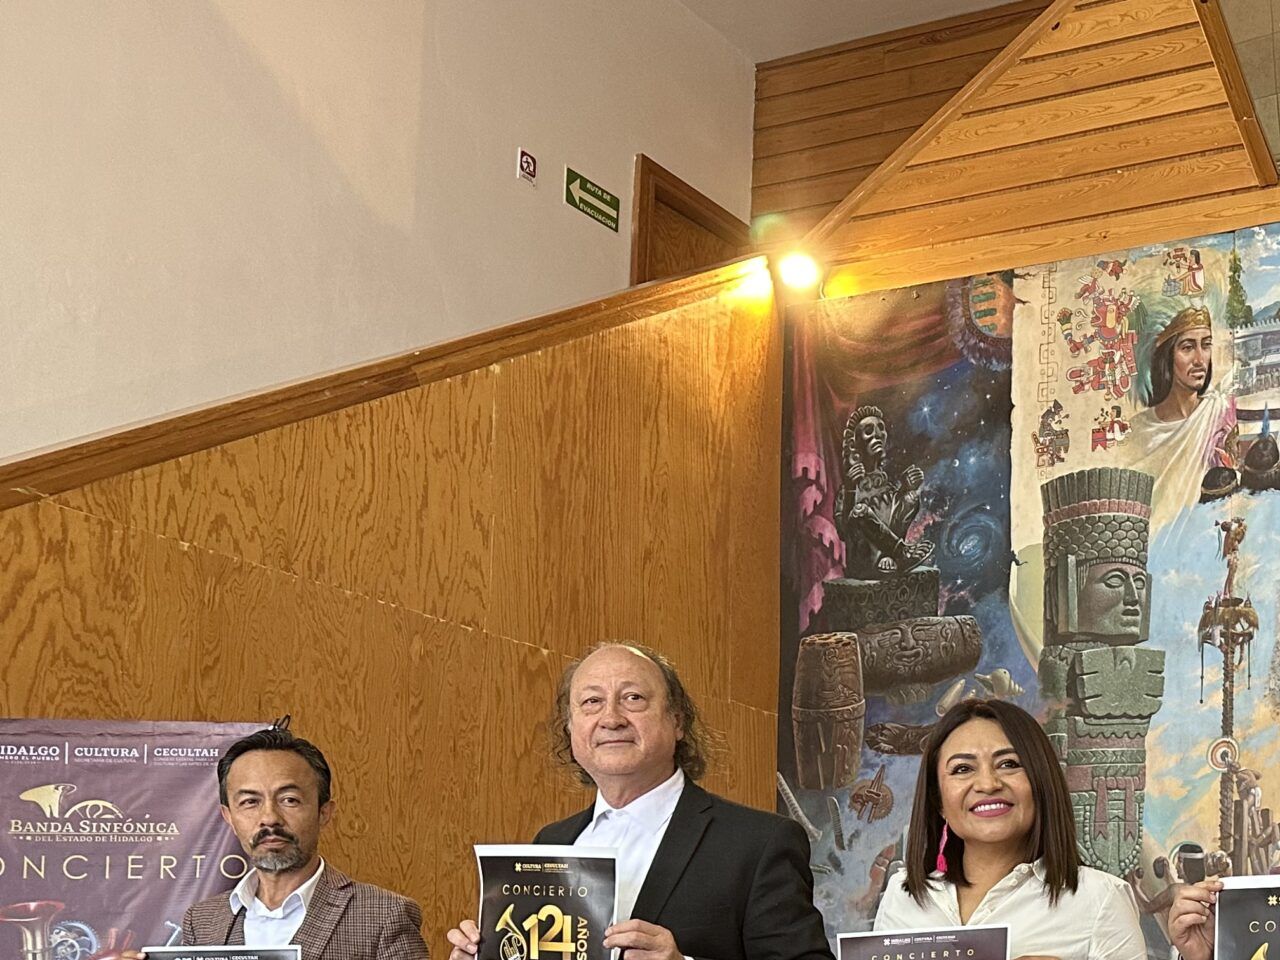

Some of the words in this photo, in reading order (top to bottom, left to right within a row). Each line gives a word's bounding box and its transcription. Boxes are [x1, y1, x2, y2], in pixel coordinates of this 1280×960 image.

[586, 182, 602, 198] RUTA
[602, 191, 611, 202] DE
[0, 745, 60, 756] IDALGO
[74, 747, 139, 757] CULTURA
[153, 748, 219, 757] CECULTAH
[10, 820, 74, 833] BANDA
[79, 818, 180, 833] SINFÓNICA
[0, 854, 248, 880] NCIERTO
[502, 884, 588, 897] CONCIERTO
